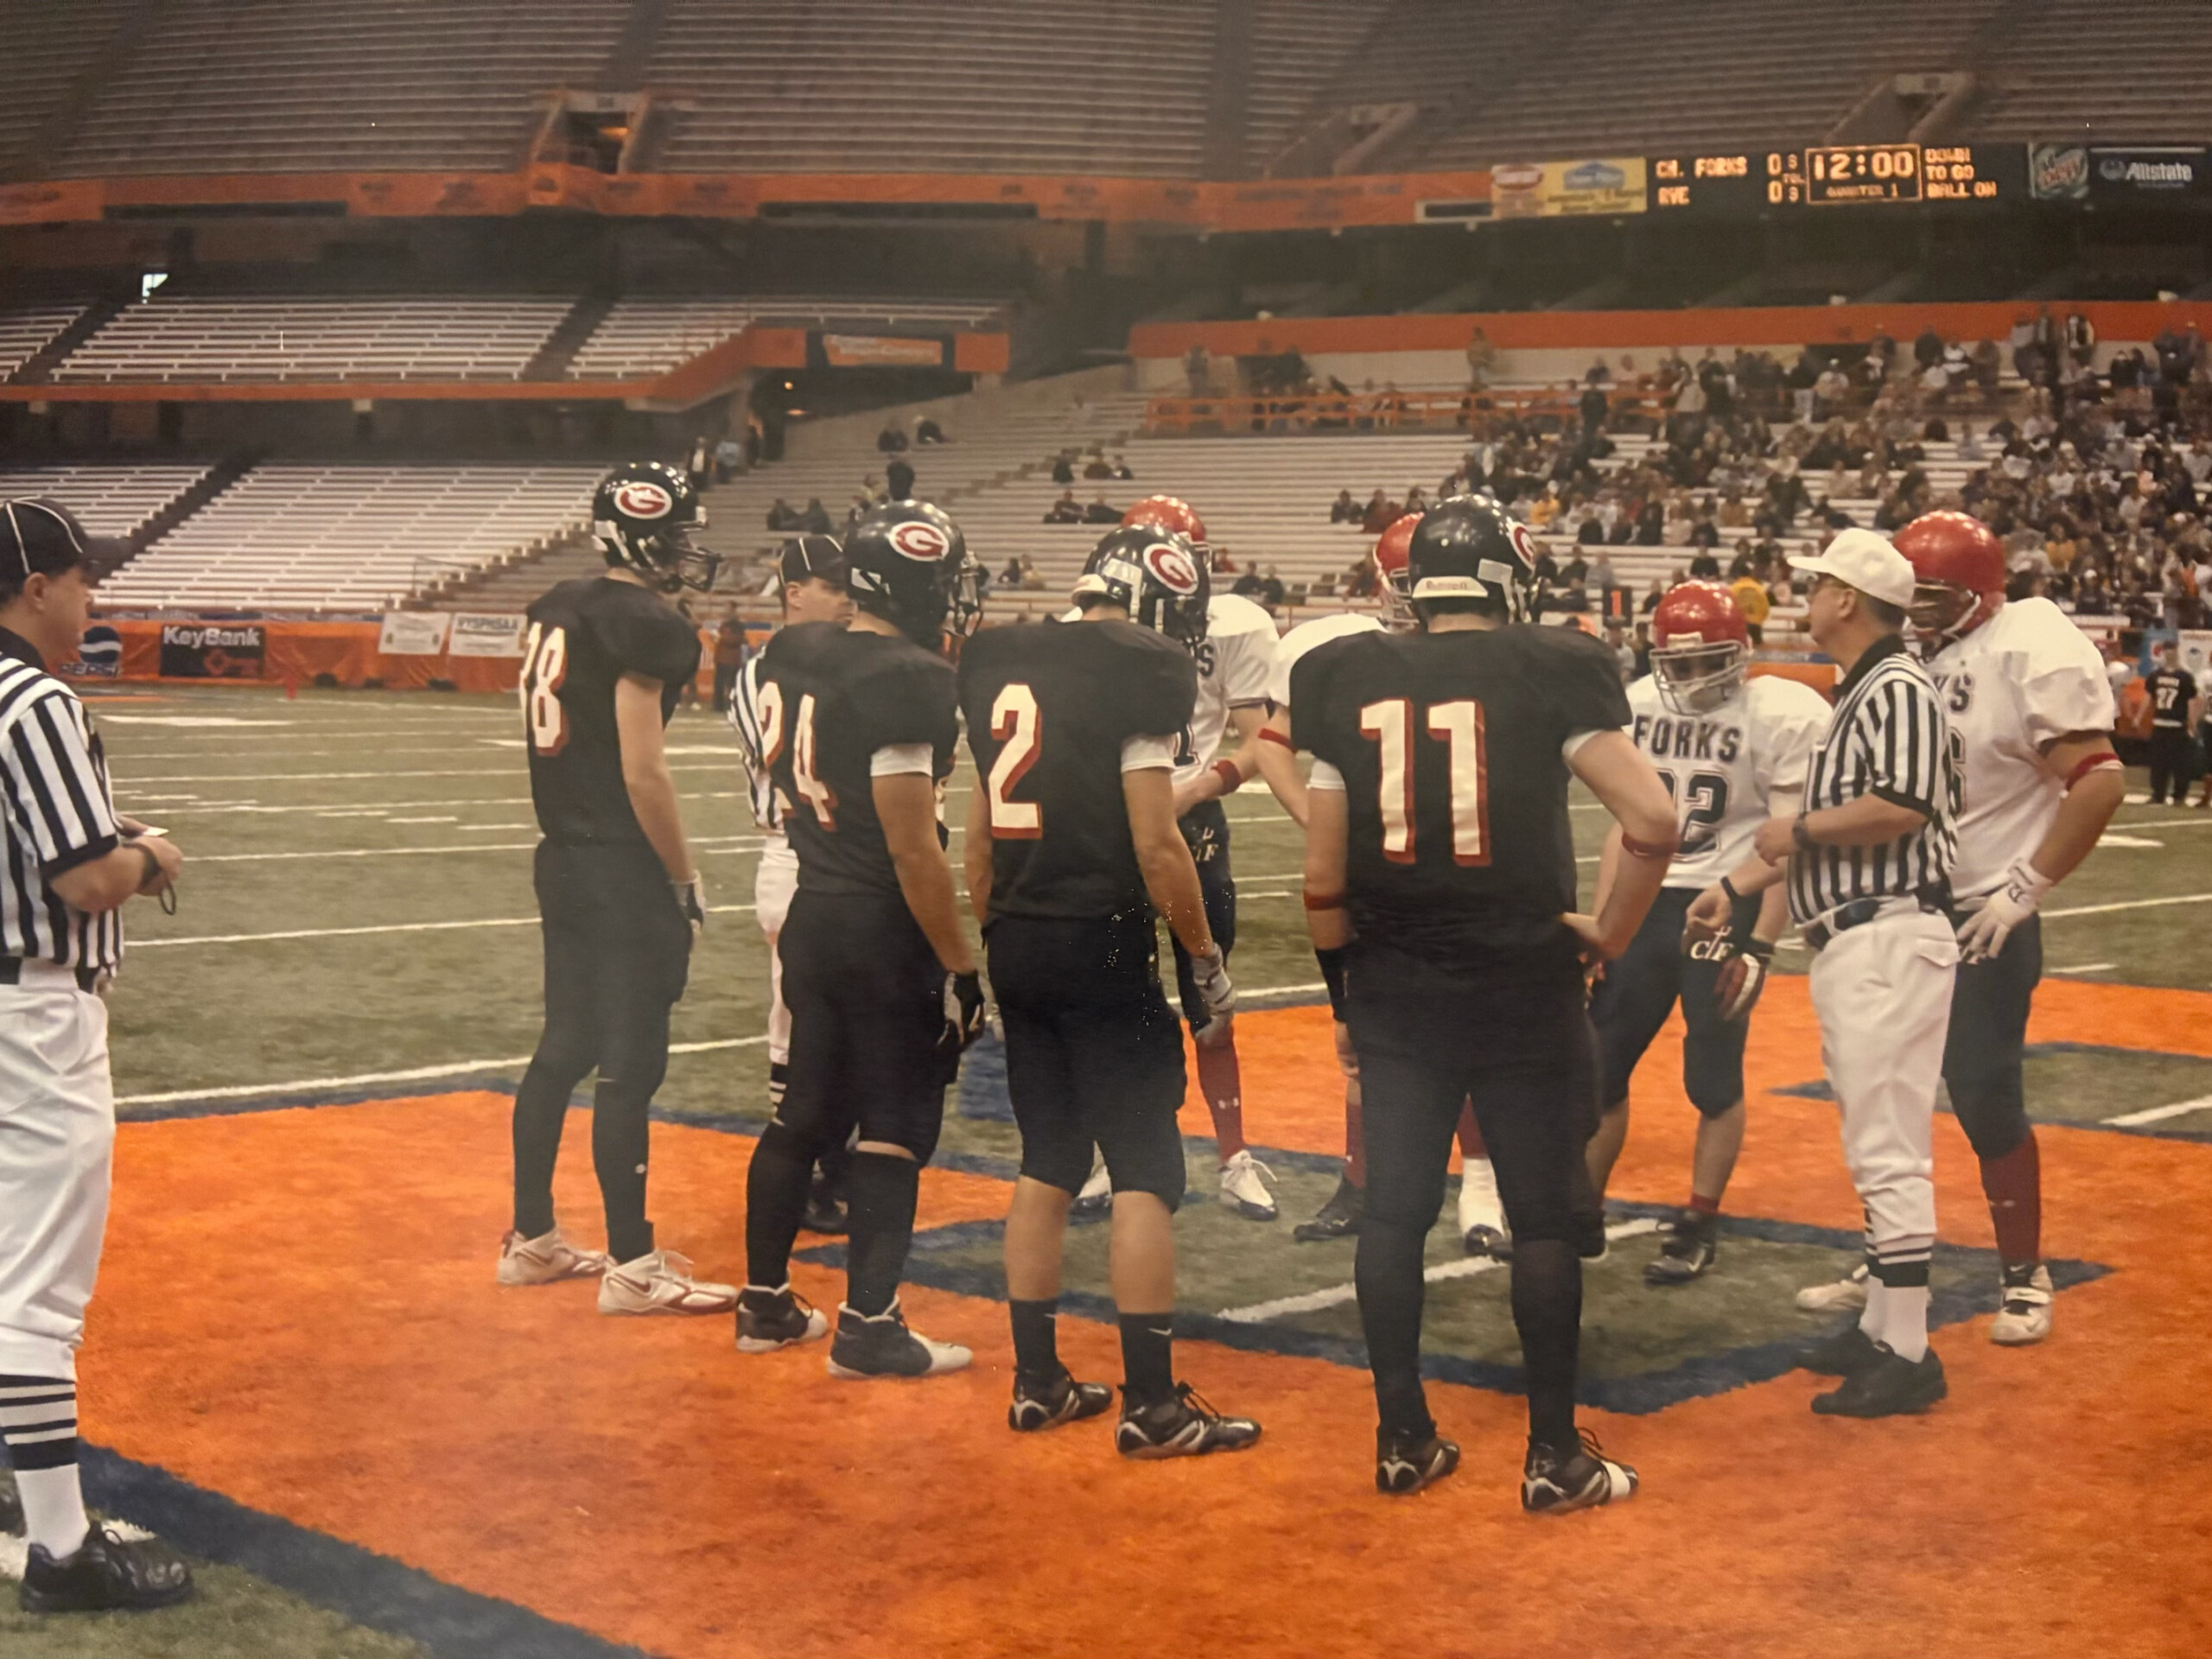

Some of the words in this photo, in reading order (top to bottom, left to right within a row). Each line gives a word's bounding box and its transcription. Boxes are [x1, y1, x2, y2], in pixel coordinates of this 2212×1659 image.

[1694, 156, 1747, 178] FORKS
[1767, 153, 1782, 176] 0
[1813, 150, 1915, 181] 12:00
[1926, 164, 1947, 180] TO
[1950, 164, 1974, 180] GO
[2125, 162, 2194, 181] Allstate
[1767, 180, 1783, 204] 0
[1890, 182, 1899, 198] 1
[1974, 181, 1998, 198] ON
[162, 626, 261, 650] KeyBank
[1633, 714, 1741, 763] FORKS
[758, 679, 838, 833] 24
[988, 682, 1043, 840] 2
[1359, 696, 1491, 867] 11
